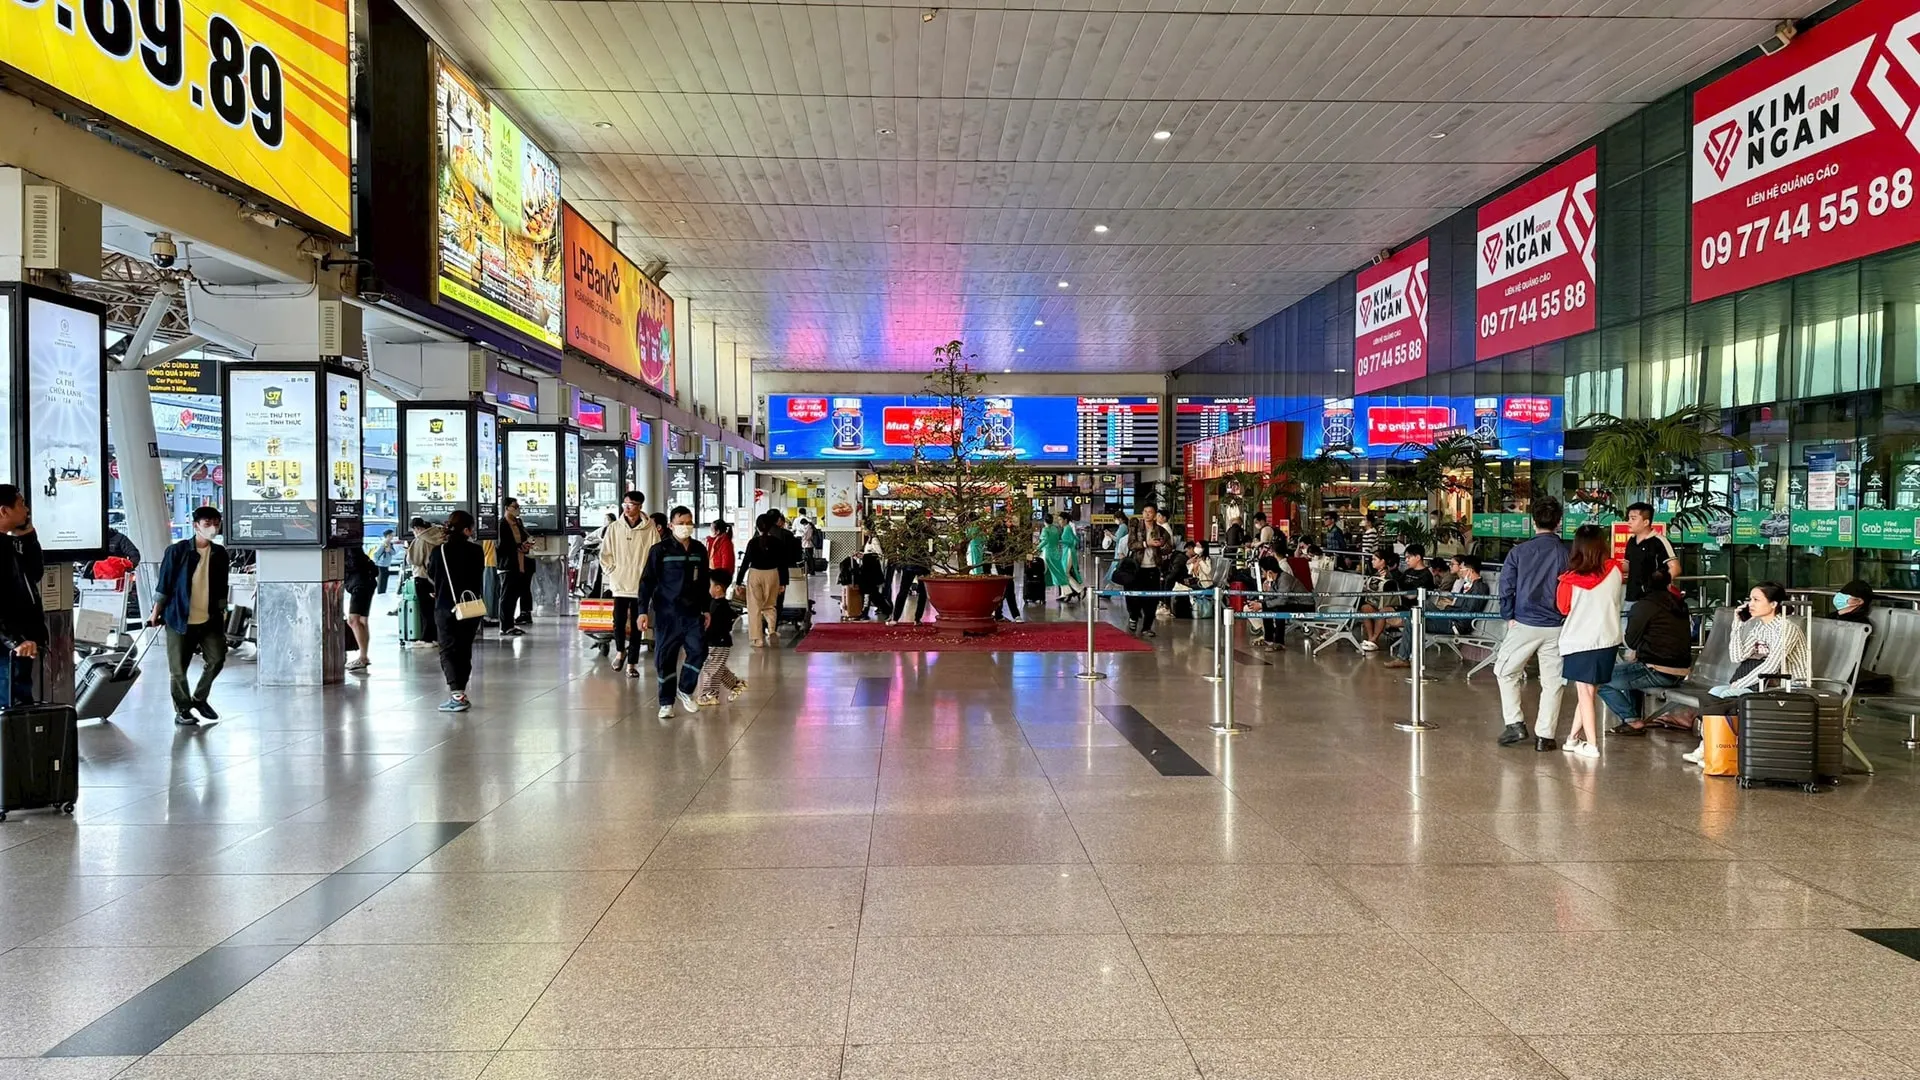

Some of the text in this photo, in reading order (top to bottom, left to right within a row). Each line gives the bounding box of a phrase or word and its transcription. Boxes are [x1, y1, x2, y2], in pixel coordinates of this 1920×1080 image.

[1748, 85, 1839, 138] KIM GROUP
[1748, 103, 1840, 170] NGAN
[1746, 162, 1840, 208] LIÊN HỆ QUẢNG CÁO
[1506, 215, 1551, 247] KIM GROUP
[1700, 167, 1914, 270] 09 77 44 55 88
[1505, 231, 1552, 270] NGAN
[573, 241, 613, 304] LPBank
[1539, 271, 1551, 285] CÁO
[1374, 284, 1392, 307] KIM
[1480, 280, 1586, 338] 09 77 44 55 88
[1373, 298, 1402, 325] NGAN
[1358, 338, 1422, 377] 09 77 44 55 88
[184, 370, 201, 378] PHÚT
[266, 391, 281, 401] G7
[886, 422, 909, 431] Mua
[1074, 496, 1081, 504] G
[1792, 524, 1810, 533] Grab
[1862, 523, 1882, 534] Grab
